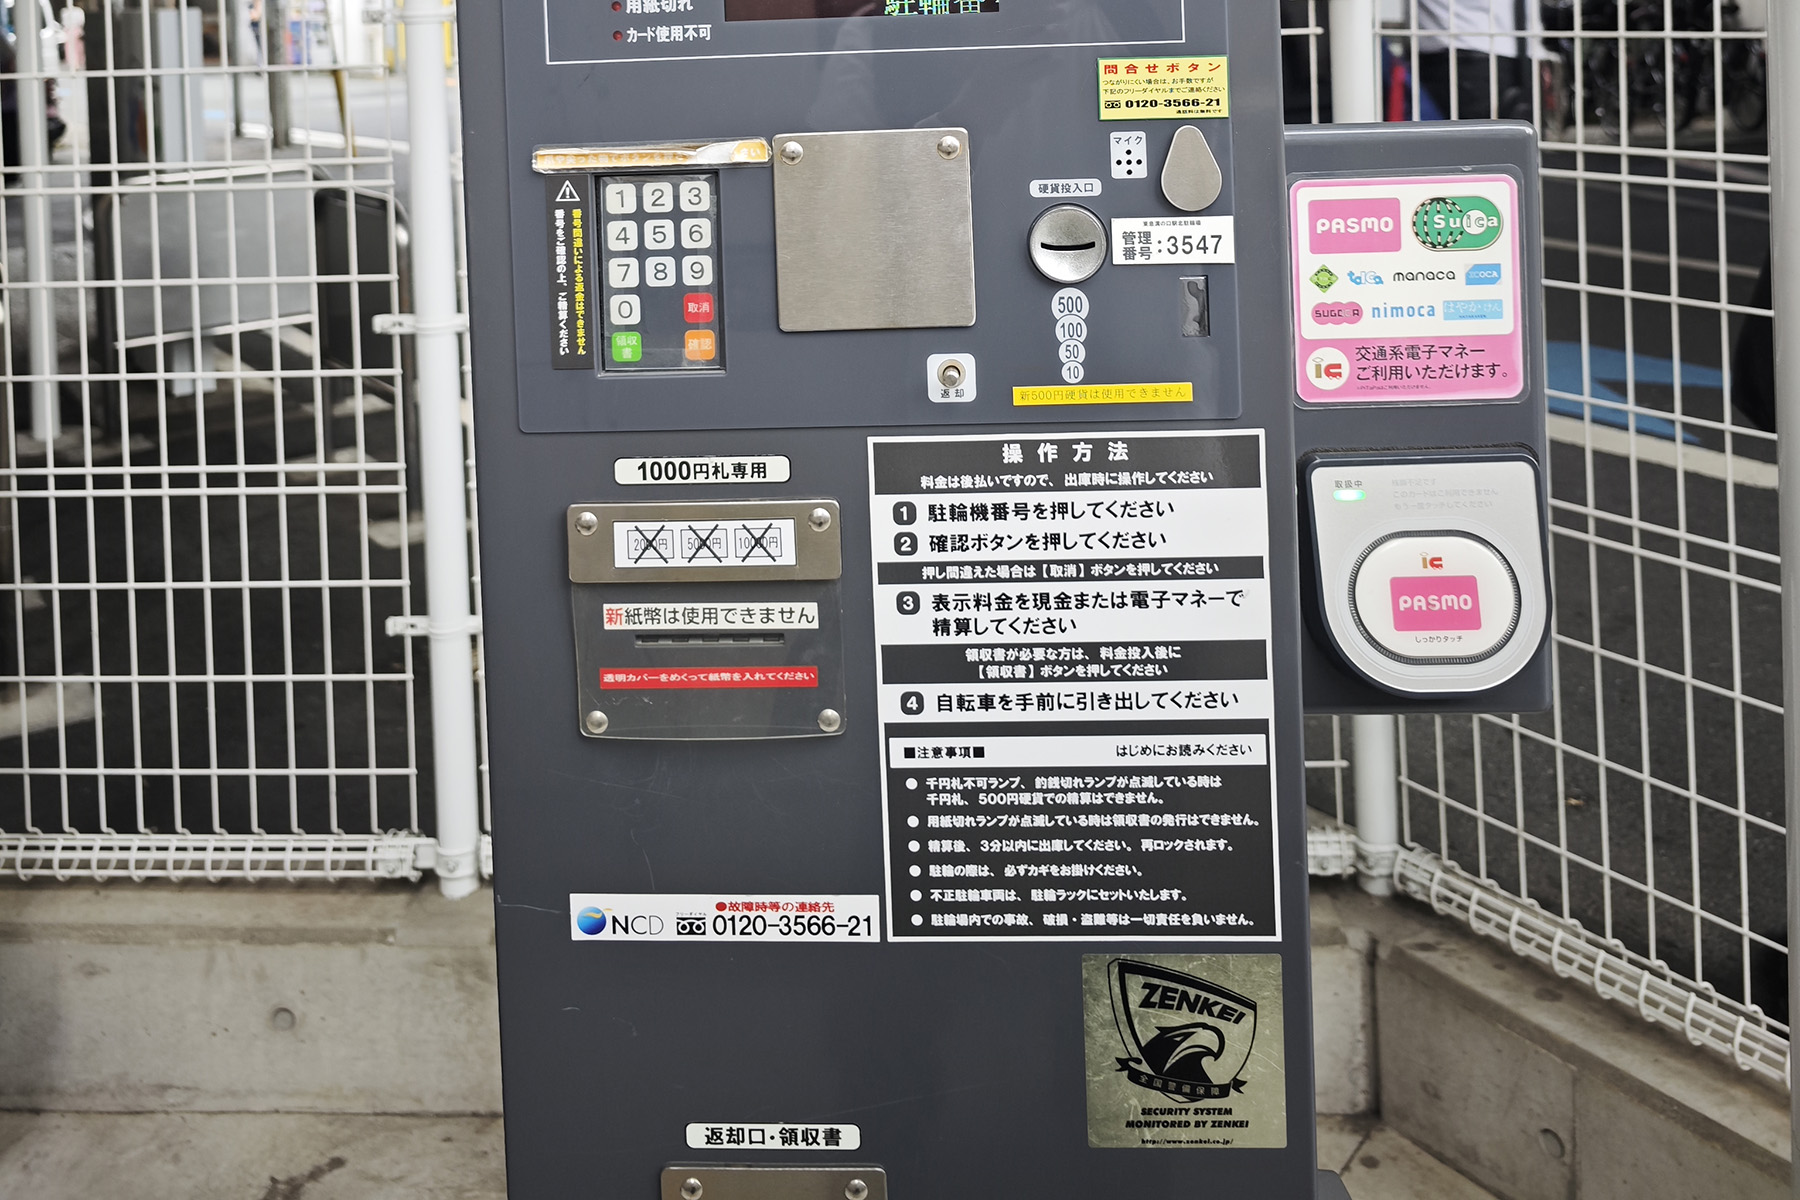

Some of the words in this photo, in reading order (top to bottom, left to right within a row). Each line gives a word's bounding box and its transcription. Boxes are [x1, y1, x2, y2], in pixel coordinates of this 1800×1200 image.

[626, 24, 712, 43] カード使用不可
[1104, 63, 1221, 75] 問合せボタン
[1125, 98, 1220, 108] 0120-3566-21
[1113, 135, 1144, 145] マイク
[688, 187, 702, 205] 3
[1038, 182, 1094, 194] 硬貨投入口
[615, 190, 625, 208] 1
[651, 189, 665, 206] 2
[1316, 217, 1394, 234] PASMO
[1433, 212, 1499, 229] Suica
[615, 226, 630, 244] 4
[652, 225, 666, 243] 5
[689, 224, 703, 242] 6
[617, 264, 631, 282] 7
[654, 263, 667, 280] 8
[690, 262, 704, 279] 9
[1393, 270, 1456, 282] manaca
[618, 301, 633, 319] 0
[687, 302, 710, 313] 取消
[1057, 296, 1083, 314] 500
[1372, 303, 1435, 318] nimoca
[1060, 323, 1083, 339] 100
[688, 338, 712, 350] 確認
[1065, 345, 1079, 359] 50
[1355, 343, 1486, 362] 交通系電子マネー
[1067, 366, 1079, 379] 10
[1356, 363, 1508, 381] ご利用いただけます。
[940, 389, 965, 399] 返却
[1002, 441, 1130, 463] 操作方法
[637, 461, 768, 481] 1000円札専用
[921, 471, 1214, 490] 料金は後払いですので、出庫時に操作してください
[1334, 480, 1363, 488] 取扱中
[928, 500, 1175, 522] 駐輪機番号を押してください
[929, 531, 1167, 553] 確認ボタンを押してください
[931, 588, 1244, 612] 表示料金を現金または電子マネーで
[1399, 595, 1473, 611] PASMO
[605, 607, 816, 627] 新紙幣は使用できません
[932, 616, 1077, 637] 精算してください
[1415, 635, 1463, 643] しっかりタッチ
[603, 672, 815, 683] 透明カバーをめくって紙幣を入れてください
[937, 691, 1240, 713] 自転車を手前に引き出してください
[1116, 743, 1253, 758] はじめにお読みください
[728, 901, 834, 913] 故障時等の連絡先
[612, 915, 664, 935] NCD
[713, 914, 872, 937] 0120-3566-21
[1138, 982, 1246, 1025] ZENKEI
[1140, 1107, 1191, 1116] SECURITY
[1193, 1107, 1233, 1116] SYSTEM
[1125, 1120, 1191, 1129] MONITORED
[1194, 1120, 1208, 1128] BY
[1210, 1120, 1249, 1128] ZENKEI
[704, 1127, 842, 1147] 返却口・領収書
